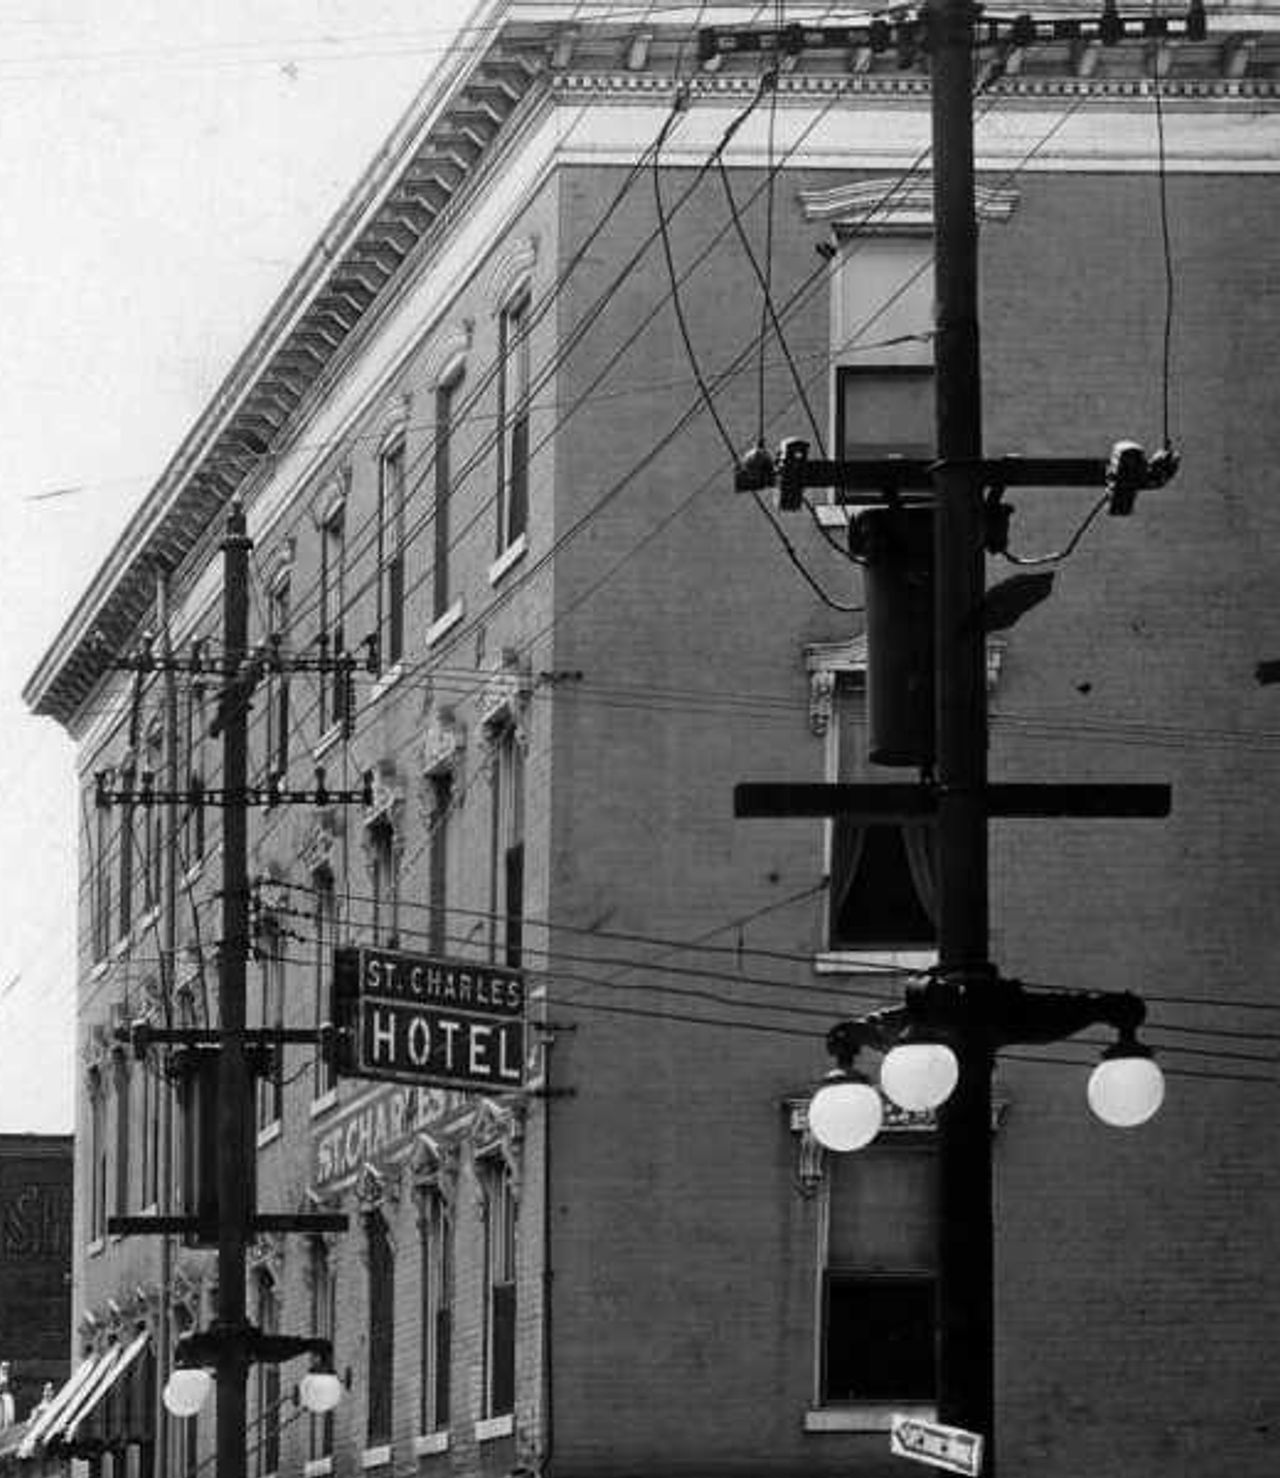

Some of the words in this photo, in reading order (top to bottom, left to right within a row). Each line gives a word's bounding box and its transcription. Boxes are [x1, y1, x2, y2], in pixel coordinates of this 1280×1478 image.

[368, 960, 404, 990] ST.
[410, 967, 520, 1007] CHARLES
[372, 1010, 520, 1079] HOTEL
